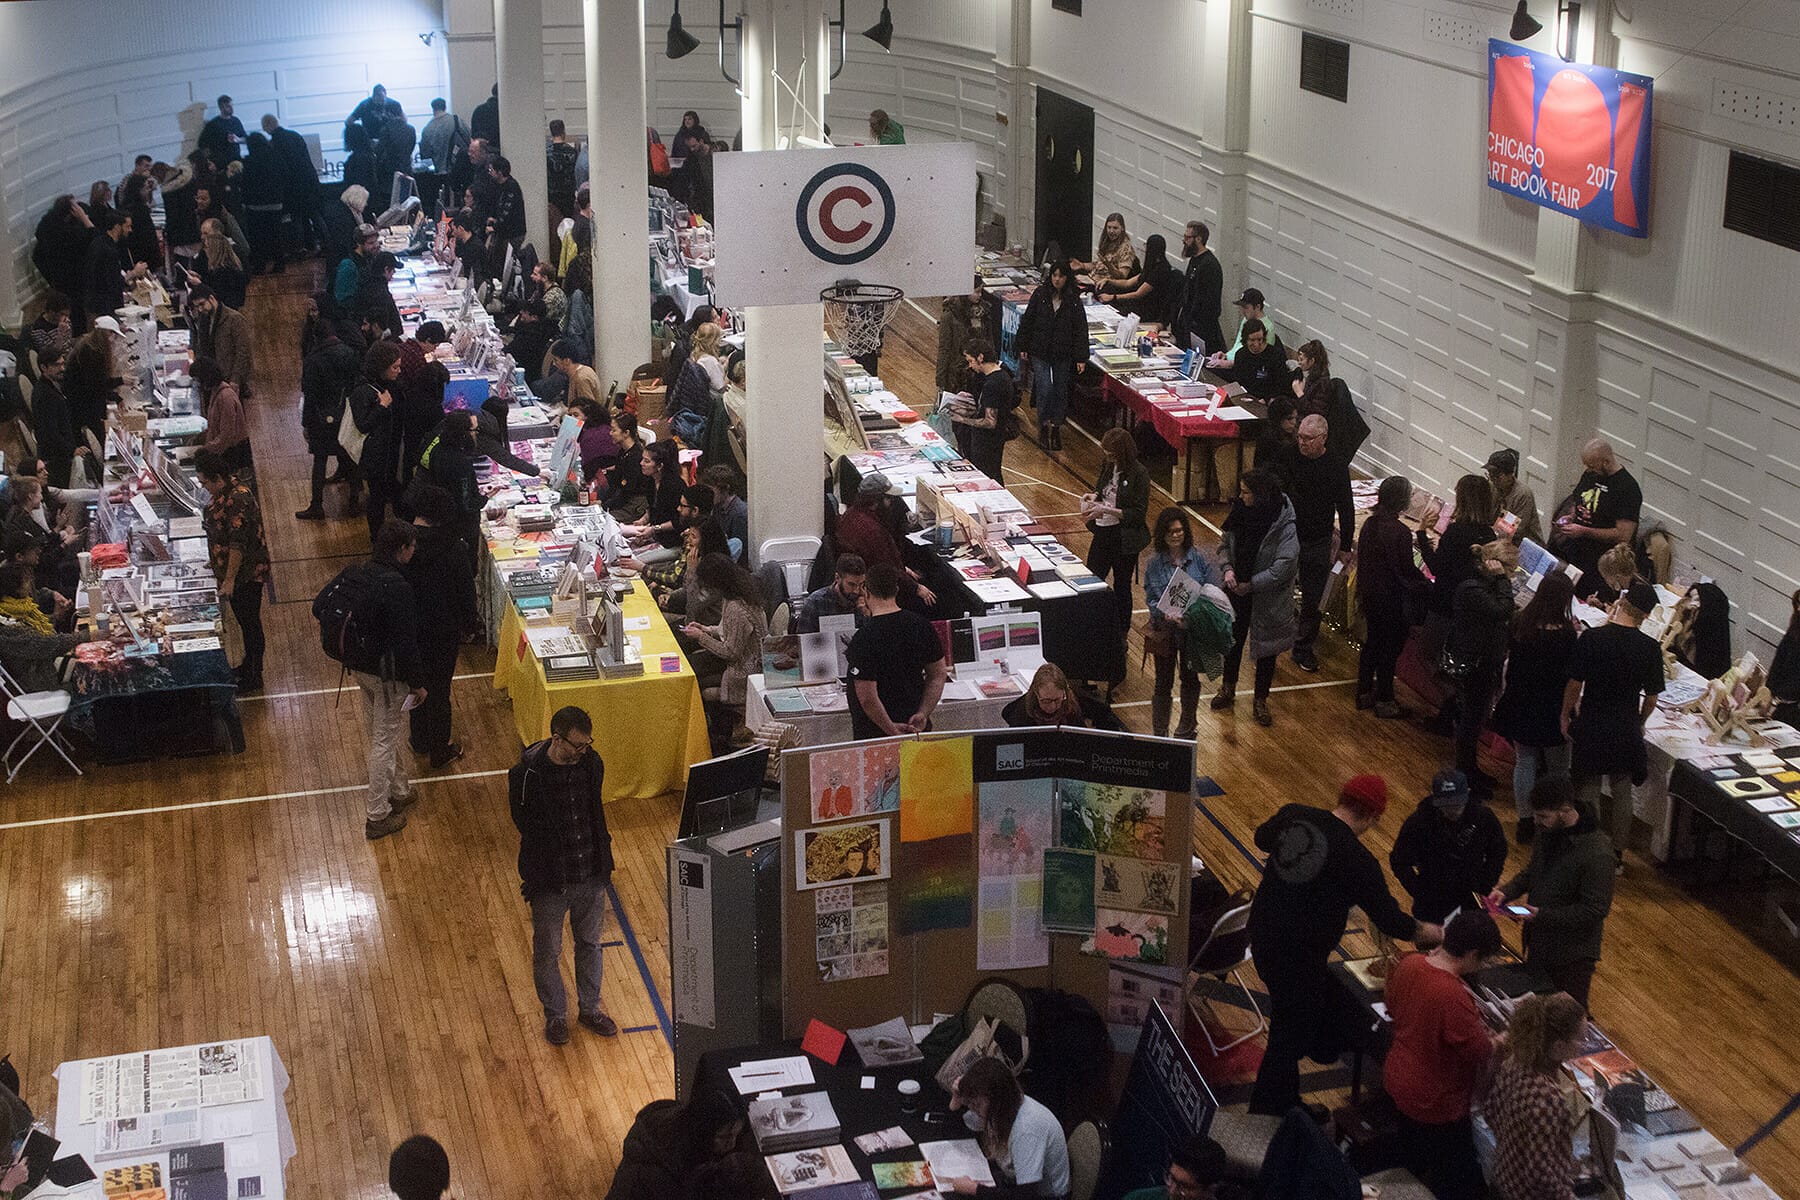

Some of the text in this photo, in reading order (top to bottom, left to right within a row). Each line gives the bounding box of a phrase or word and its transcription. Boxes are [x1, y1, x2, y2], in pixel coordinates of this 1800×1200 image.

[1488, 131, 1545, 168] CHICAGO
[1510, 167, 1548, 200] BOOK
[1551, 181, 1581, 210] FAIR
[1586, 163, 1619, 192] 2017
[818, 186, 873, 244] C
[998, 759, 1023, 769] SAIC
[1091, 753, 1169, 770] Department of
[1091, 763, 1149, 777] Printmedia
[679, 861, 689, 885] SAIC
[1147, 1017, 1207, 1134] THE SEEN
